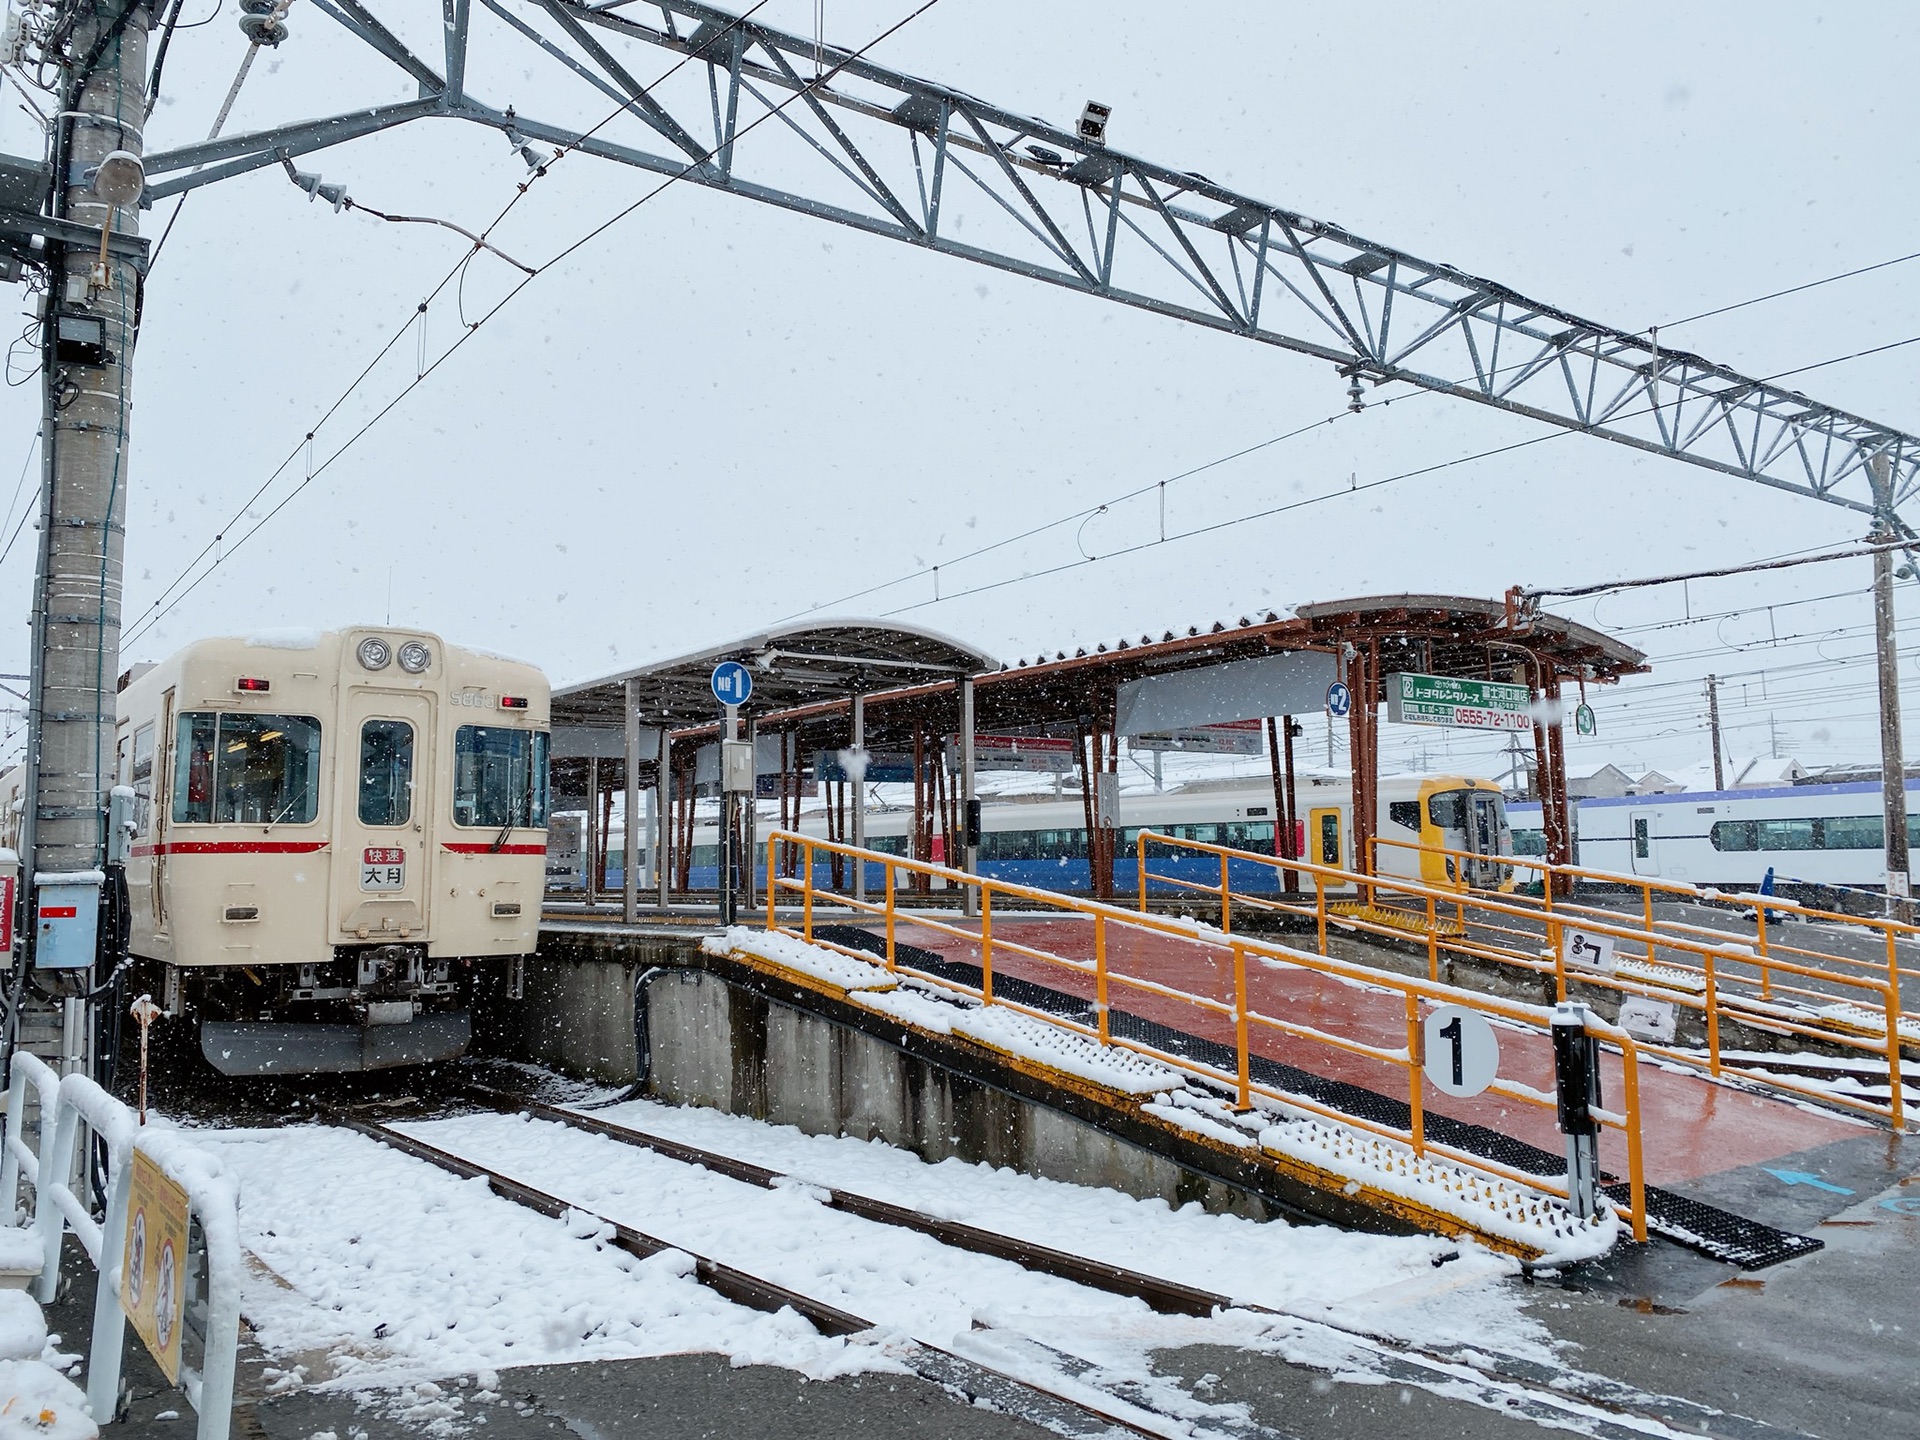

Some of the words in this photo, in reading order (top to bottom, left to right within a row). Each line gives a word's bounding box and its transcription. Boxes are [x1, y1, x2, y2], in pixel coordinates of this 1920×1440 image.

[733, 669, 743, 698] 1
[450, 691, 495, 708] 5863
[1338, 687, 1347, 711] 2
[1416, 688, 1480, 703] トヨタレンタリース
[1455, 708, 1530, 729] 0555-72-1100
[1583, 709, 1591, 729] 3
[368, 849, 400, 862] 快速
[365, 867, 401, 884] 大月
[1439, 1016, 1463, 1087] 1
